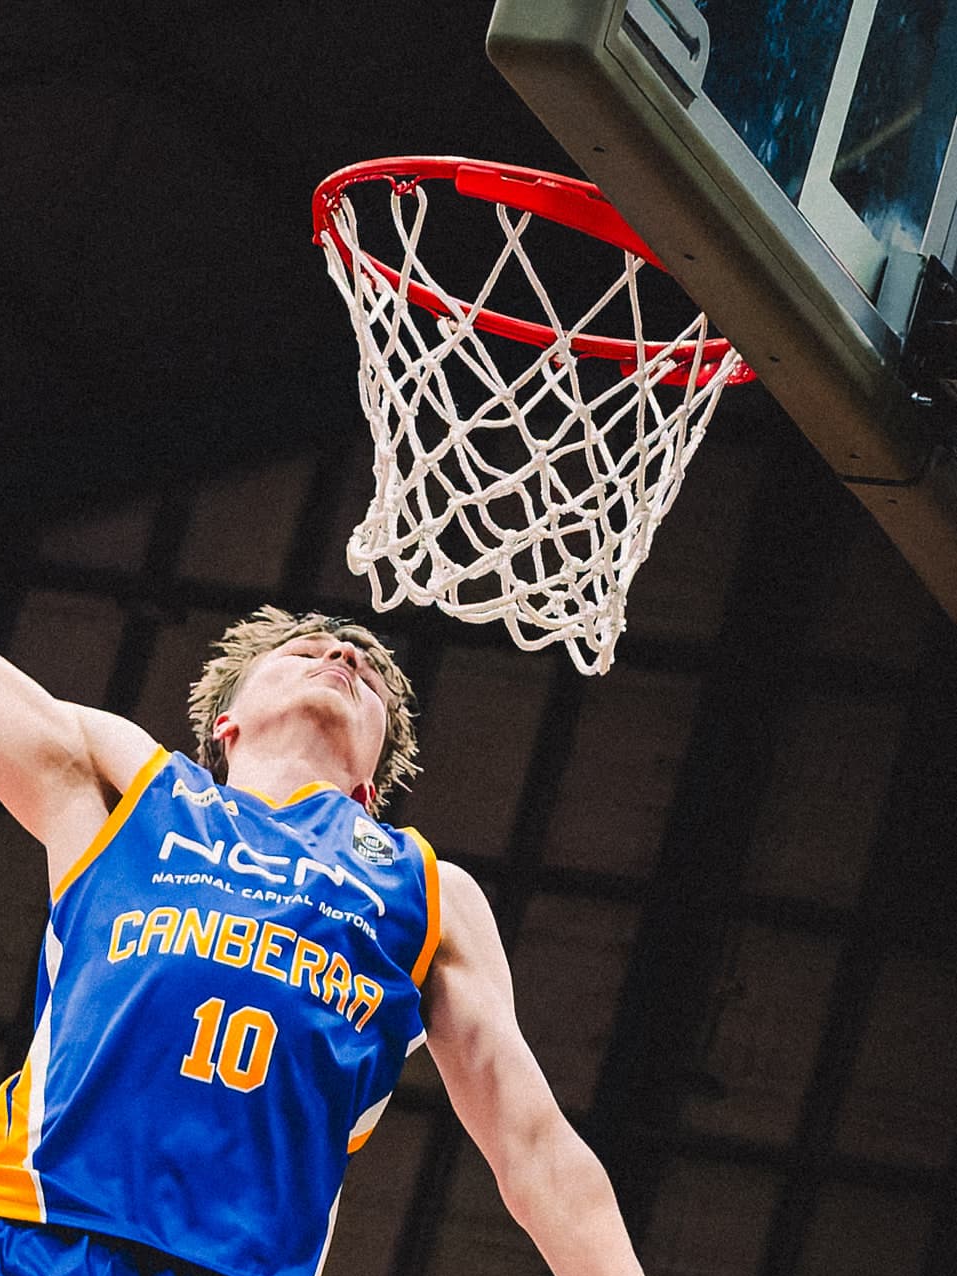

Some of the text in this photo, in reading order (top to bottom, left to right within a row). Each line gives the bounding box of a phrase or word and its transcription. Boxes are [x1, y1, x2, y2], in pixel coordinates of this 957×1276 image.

[152, 872, 377, 941] NATIONAL CAPITAL MOTORS
[159, 831, 386, 917] NCM
[107, 907, 384, 1032] CANBERRA
[180, 997, 278, 1093] 10
